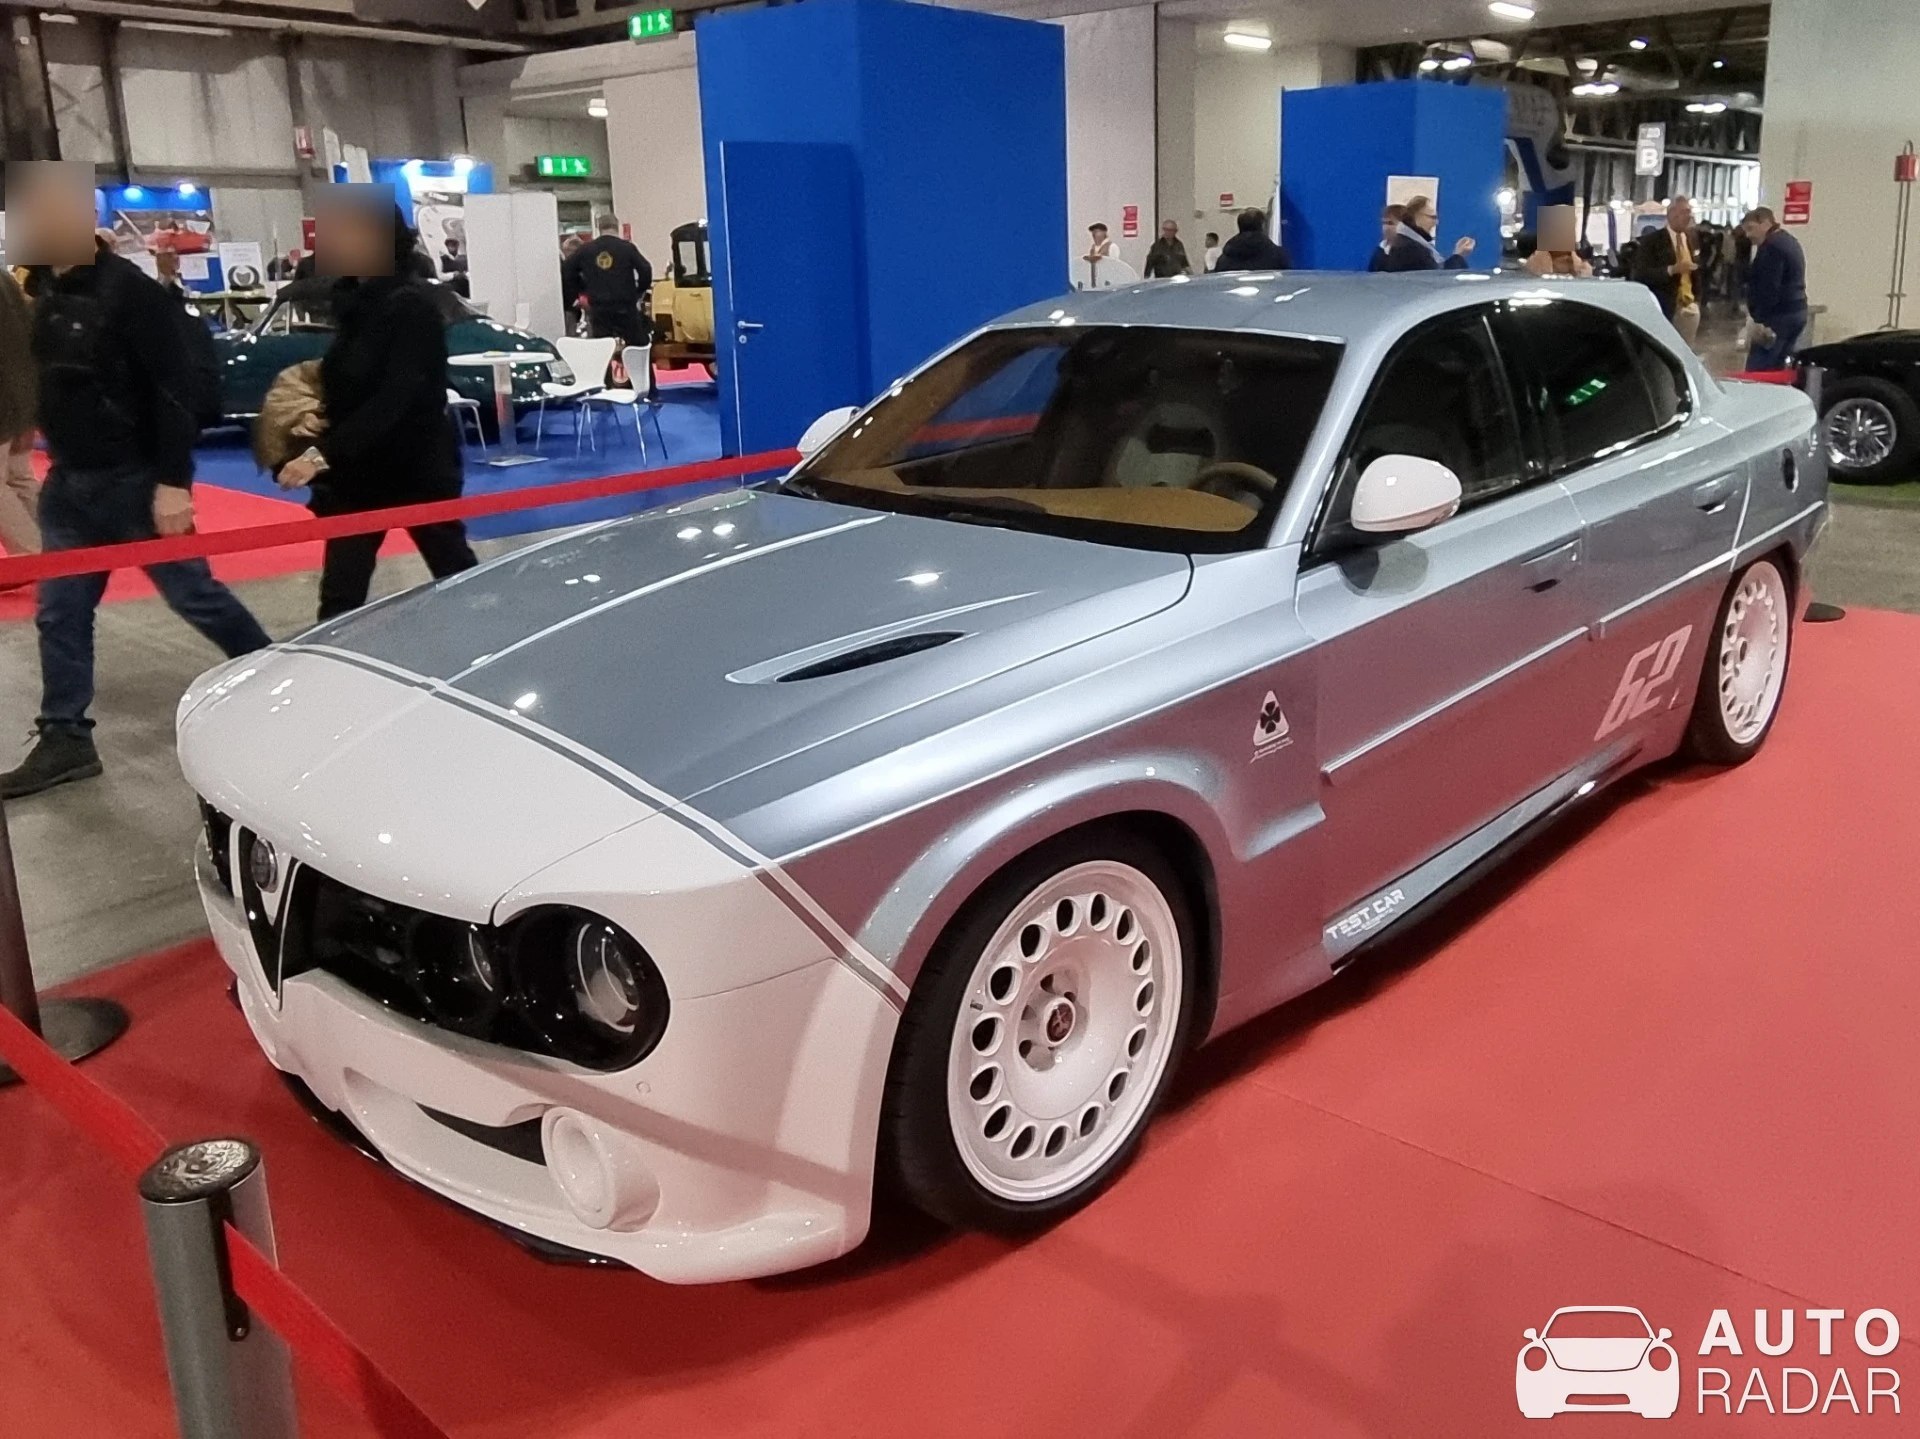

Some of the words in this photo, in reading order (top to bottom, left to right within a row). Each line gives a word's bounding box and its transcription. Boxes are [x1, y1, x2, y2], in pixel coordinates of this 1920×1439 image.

[1642, 148, 1658, 168] B
[1594, 624, 1692, 741] 62
[1325, 906, 1370, 939] TEST
[1372, 888, 1405, 914] CAR
